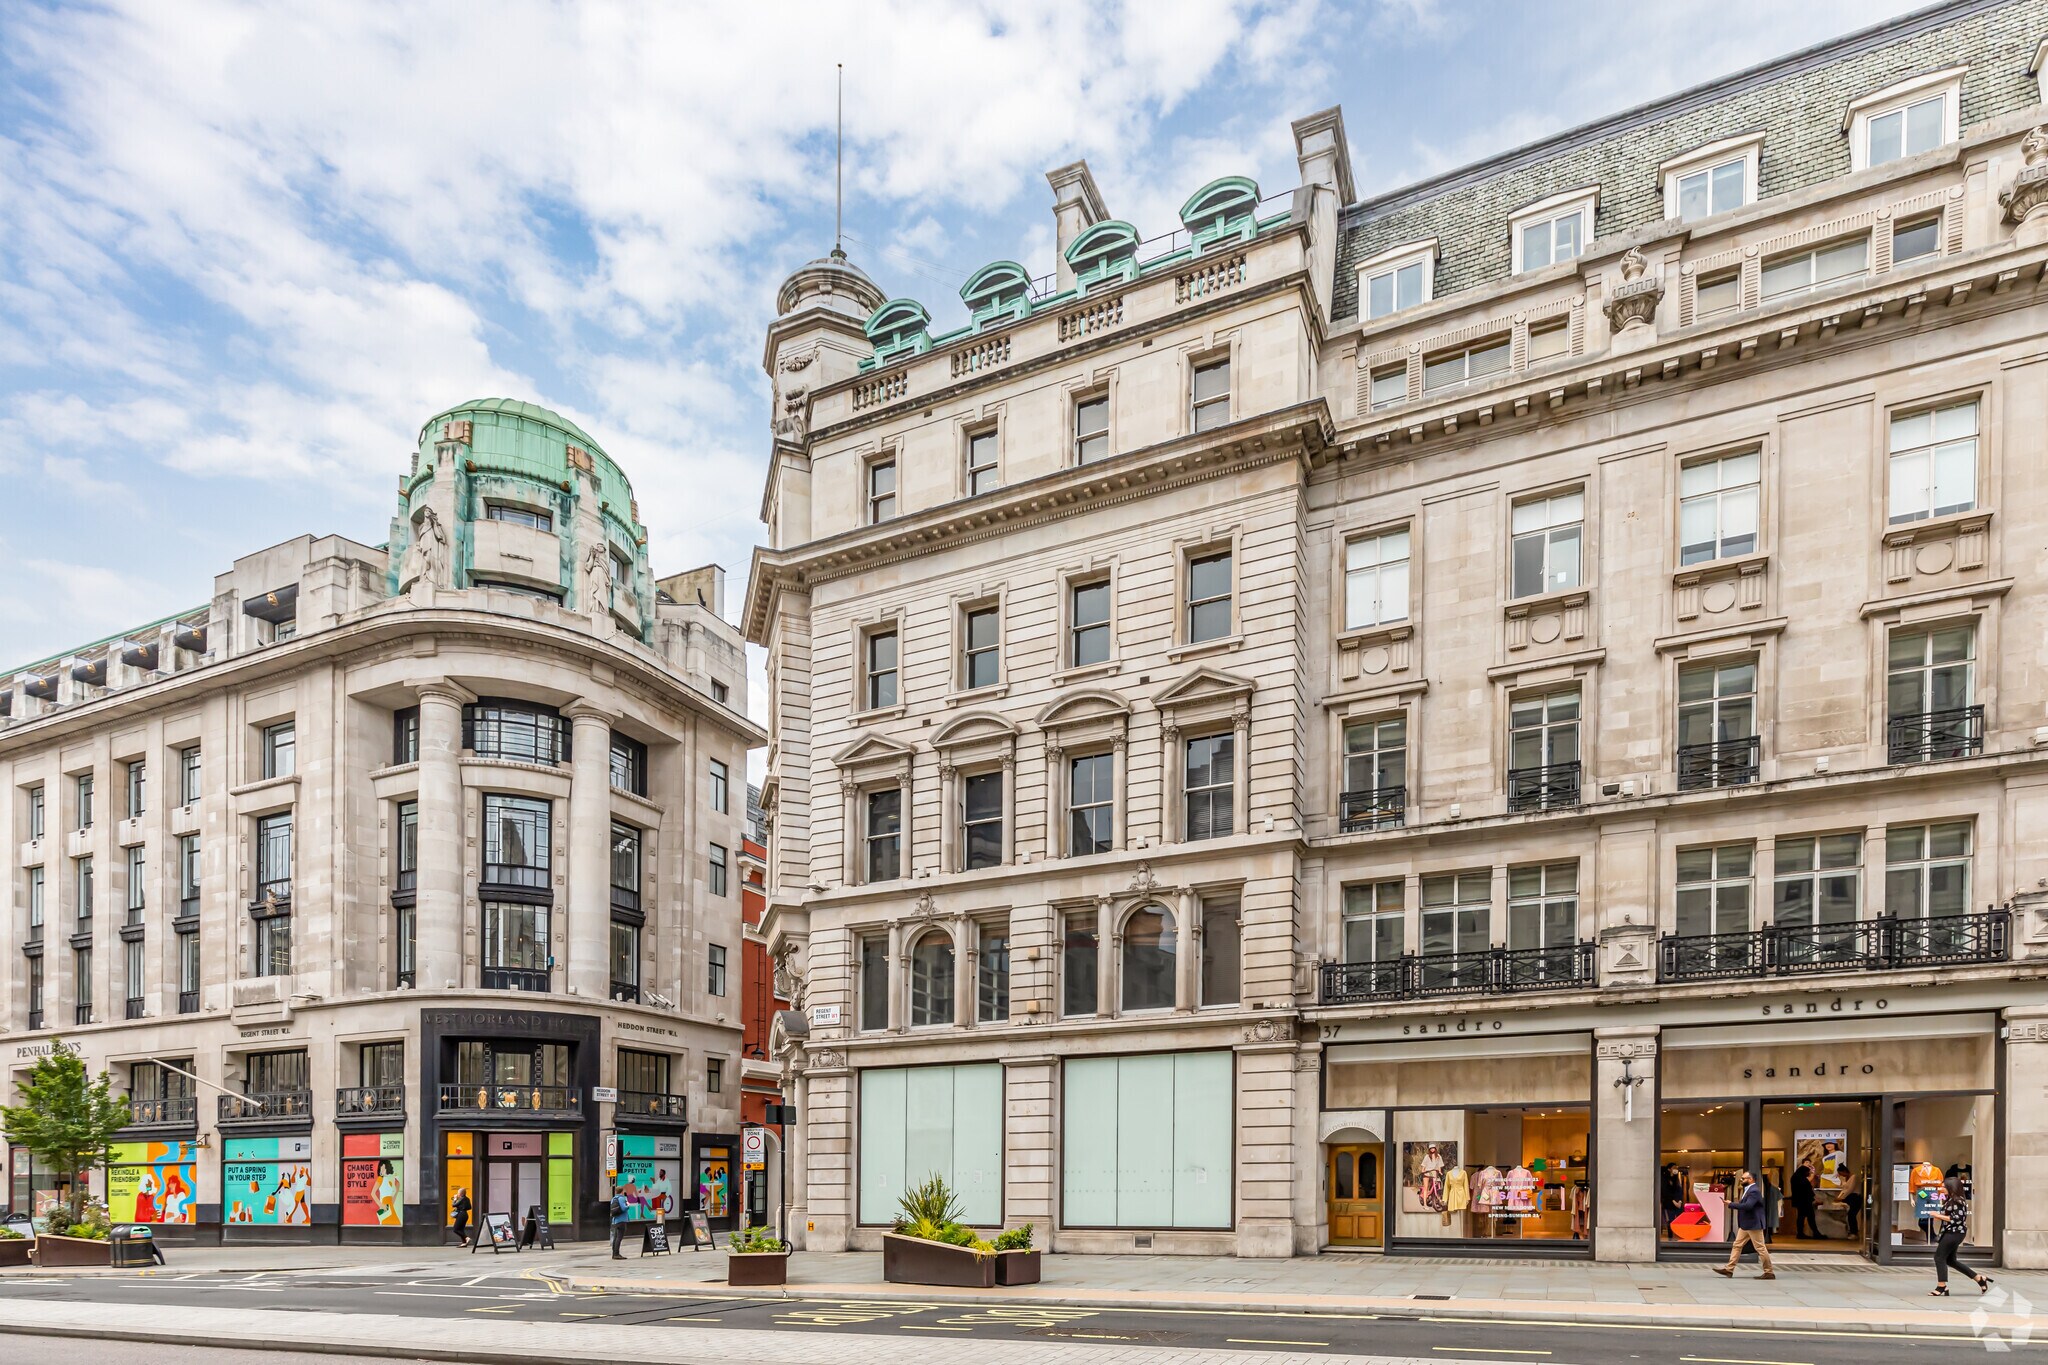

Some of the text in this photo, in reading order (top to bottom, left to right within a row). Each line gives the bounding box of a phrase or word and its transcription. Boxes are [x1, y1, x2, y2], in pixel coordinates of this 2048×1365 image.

[1762, 997, 1888, 1015] sandro
[424, 1013, 541, 1026] WESTMORLAND
[617, 1022, 644, 1031] HEDDON
[646, 1026, 665, 1034] STREET
[1318, 1025, 1342, 1038] 137
[1403, 1019, 1502, 1034] sandro
[241, 1030, 259, 1038] REGENT
[1744, 1062, 1874, 1079] sandro
[1500, 1191, 1528, 1200] SALE
[808, 1222, 814, 1231] H
